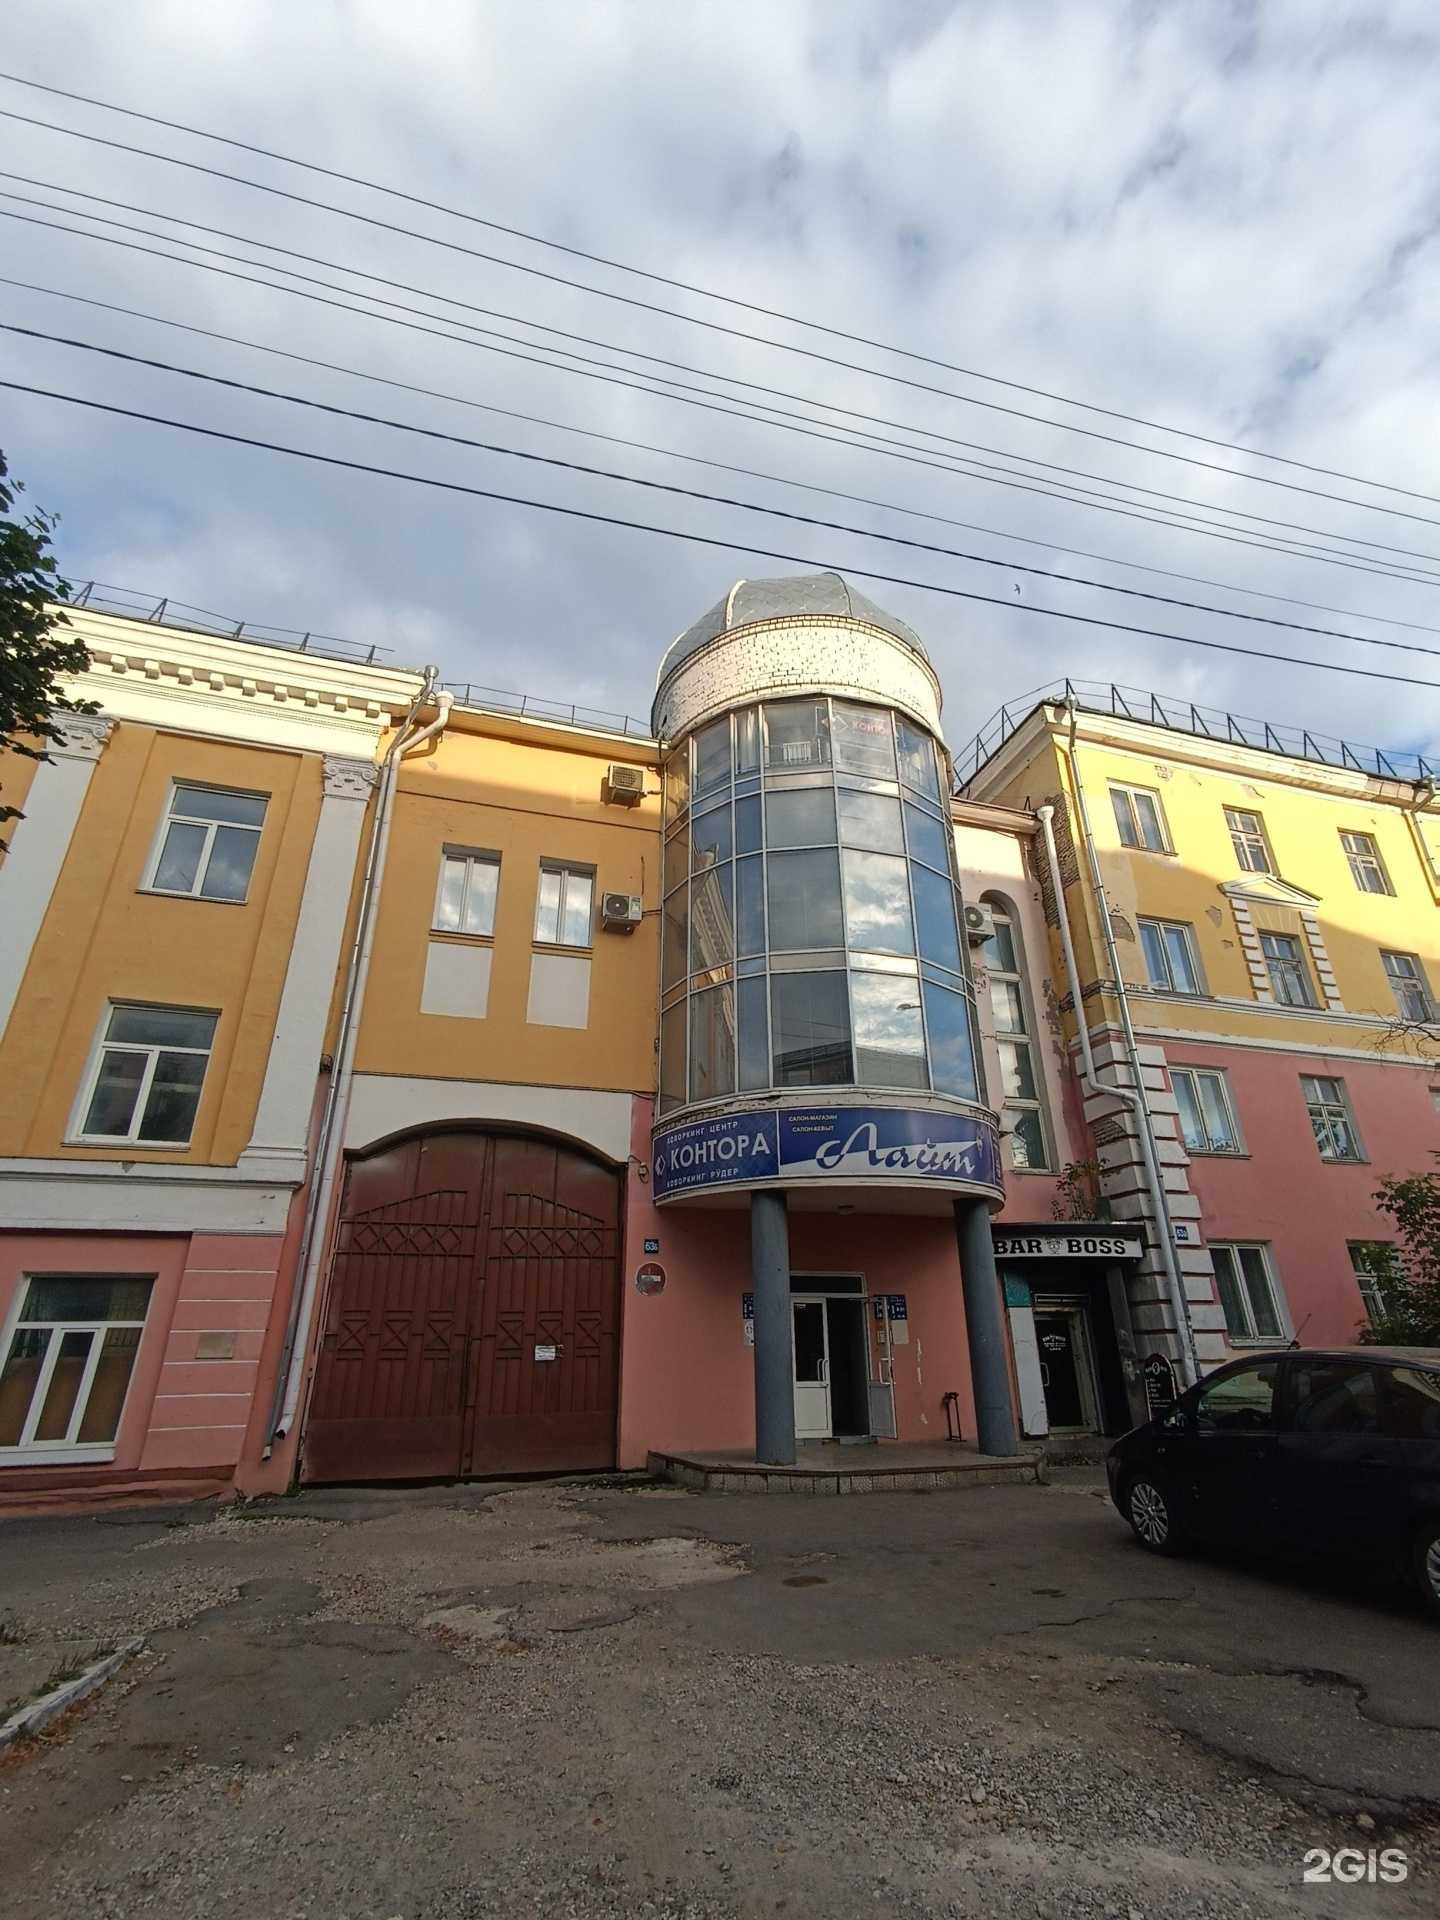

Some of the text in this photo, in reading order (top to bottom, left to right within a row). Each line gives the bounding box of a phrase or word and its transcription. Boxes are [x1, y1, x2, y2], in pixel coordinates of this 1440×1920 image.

[709, 1121, 738, 1133] ЦЕНТР
[670, 1132, 771, 1171] КОНТОРА
[816, 1122, 976, 1174] Лайт
[993, 1239, 1043, 1255] BAR
[1066, 1238, 1126, 1255] BOSS
